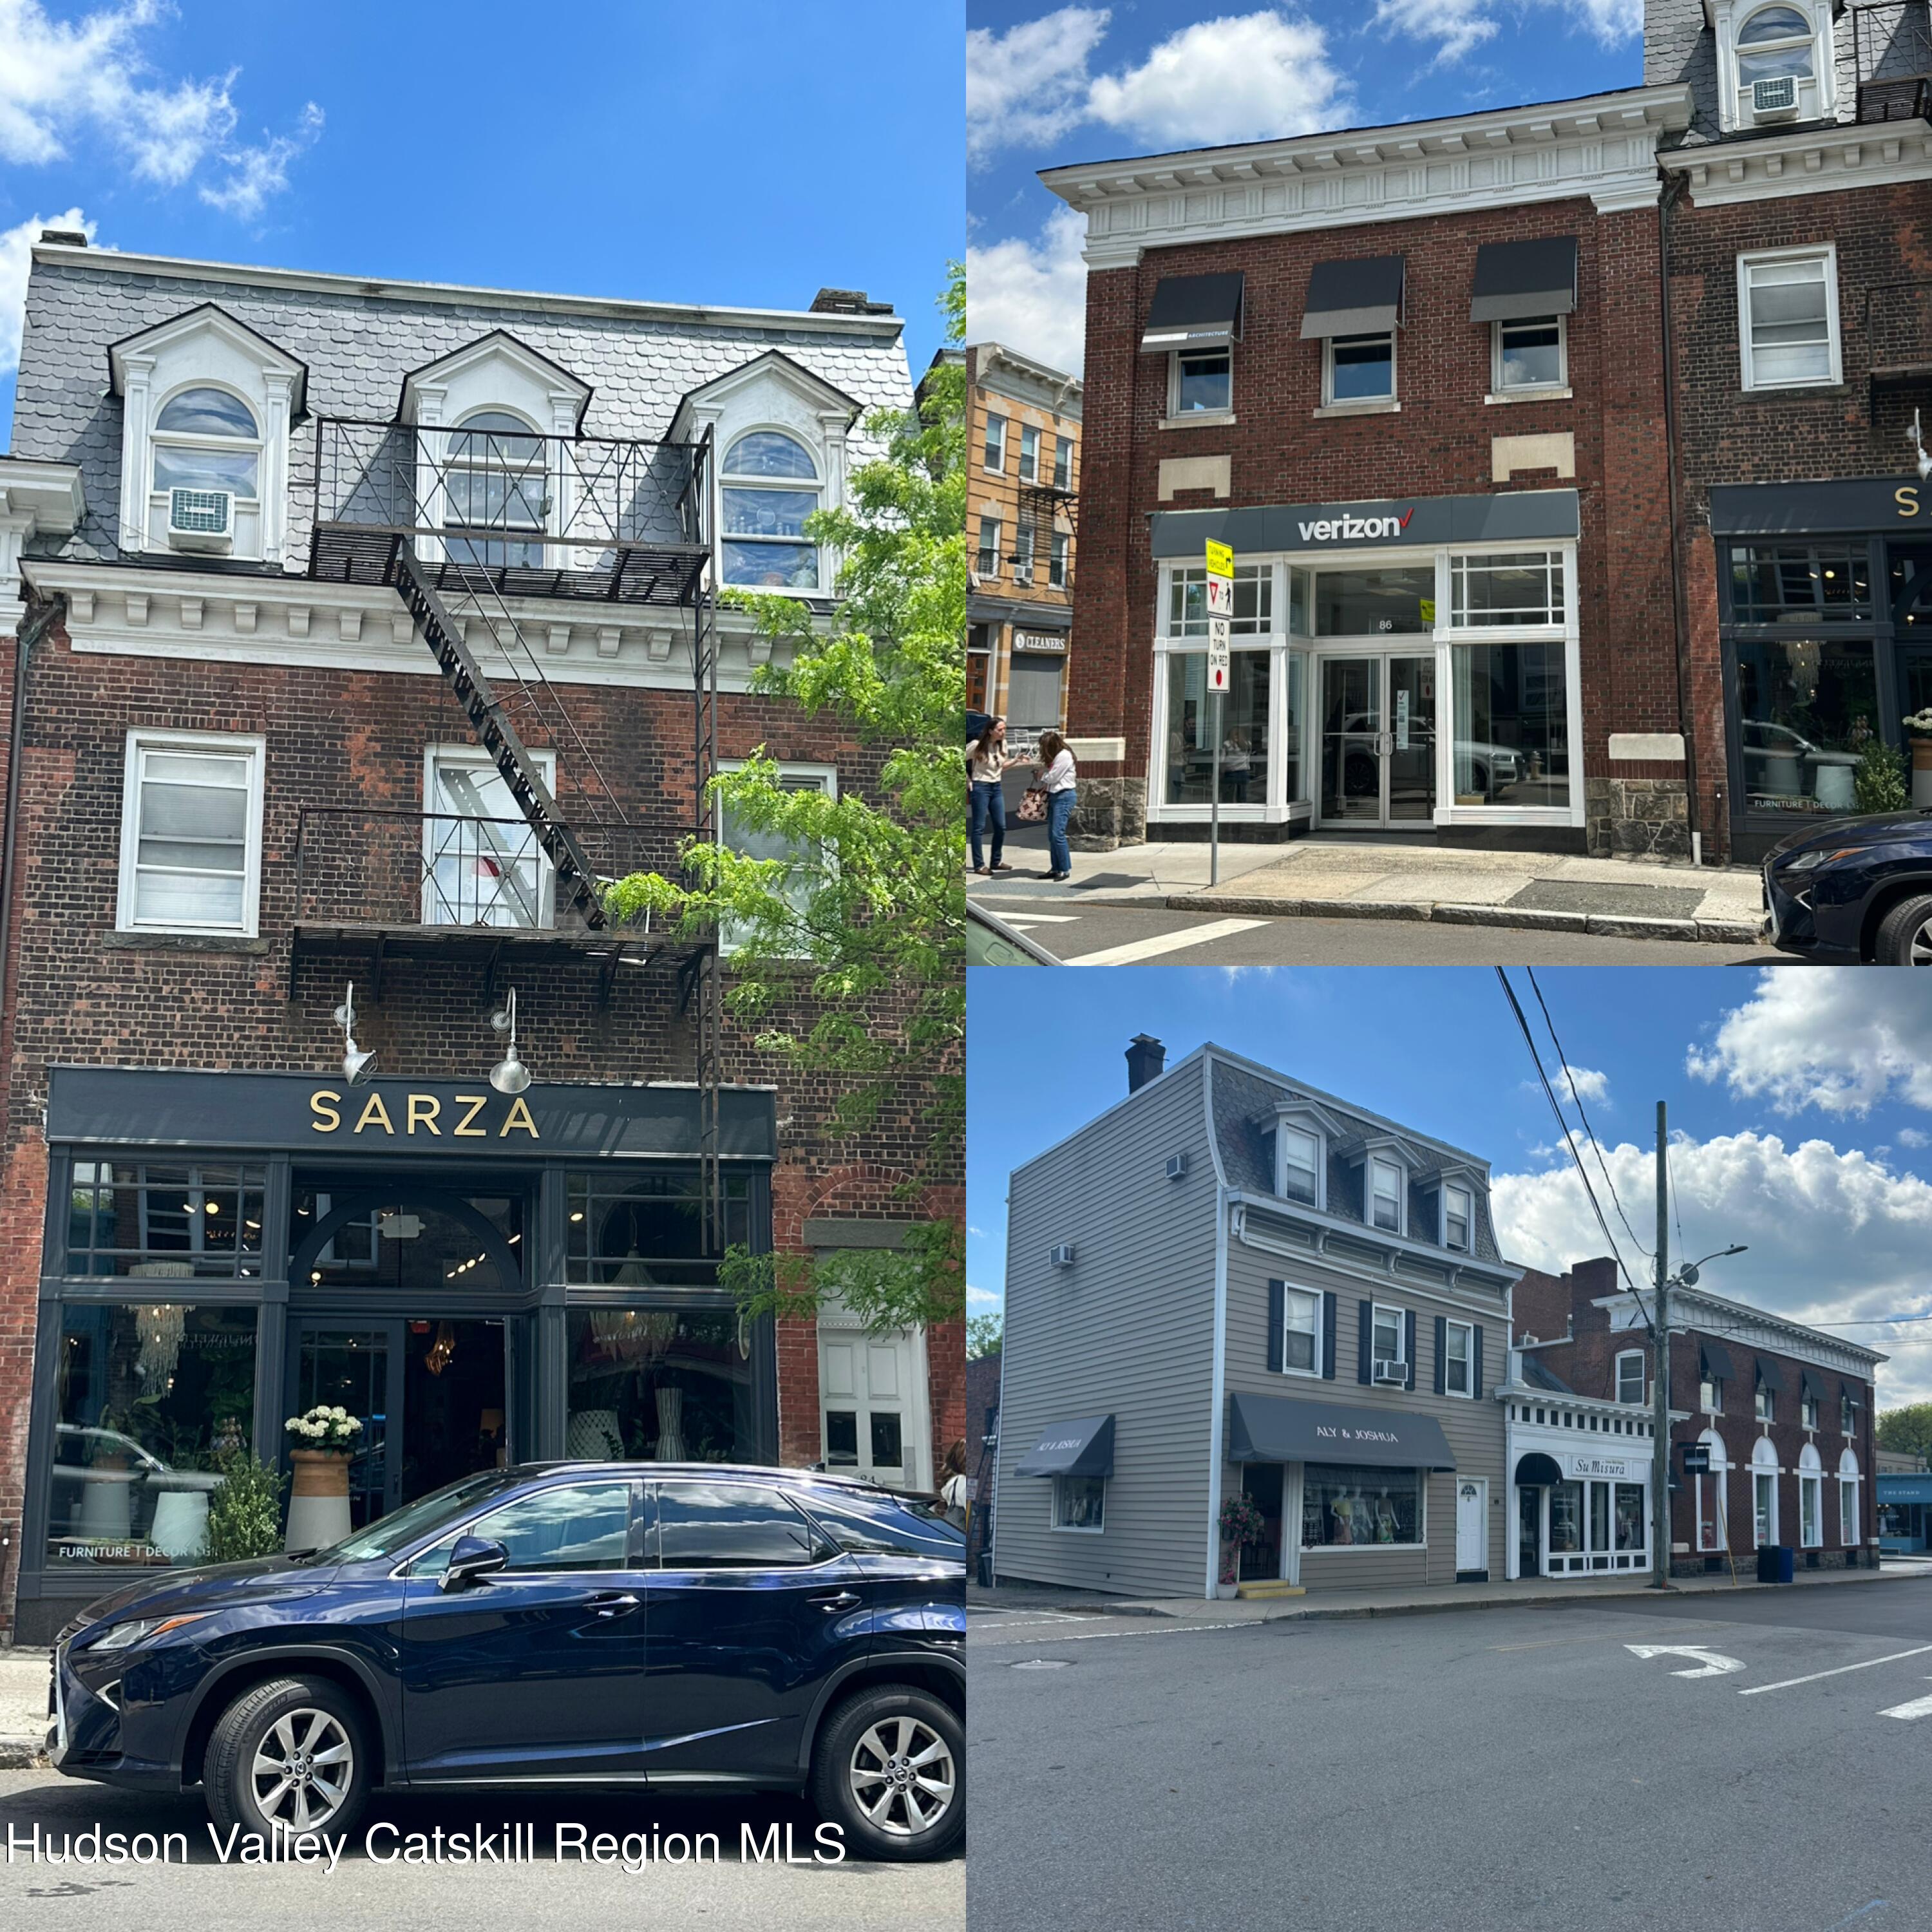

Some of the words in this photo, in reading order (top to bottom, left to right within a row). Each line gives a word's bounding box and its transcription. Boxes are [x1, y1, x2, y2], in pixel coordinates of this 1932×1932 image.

[1297, 513, 1401, 542] verizon
[1208, 545, 1225, 558] TURNING
[1209, 558, 1226, 571] VEHICLES
[1215, 621, 1225, 636] NO
[1379, 620, 1392, 629] 86
[1027, 636, 1066, 650] CLEANERS
[1213, 638, 1226, 651] TURN
[1210, 654, 1218, 666] ON
[1218, 654, 1227, 667] RED
[1754, 799, 1803, 809] FURNITURE
[310, 1089, 540, 1139] SARZA
[1316, 1426, 1336, 1437] ALY
[1341, 1428, 1351, 1439] &
[1355, 1429, 1399, 1443] JOSHUA
[1576, 1459, 1589, 1472] Su
[1591, 1460, 1625, 1474] Misura
[59, 1546, 131, 1558] FURNITURE
[146, 1546, 188, 1557] DECOR
